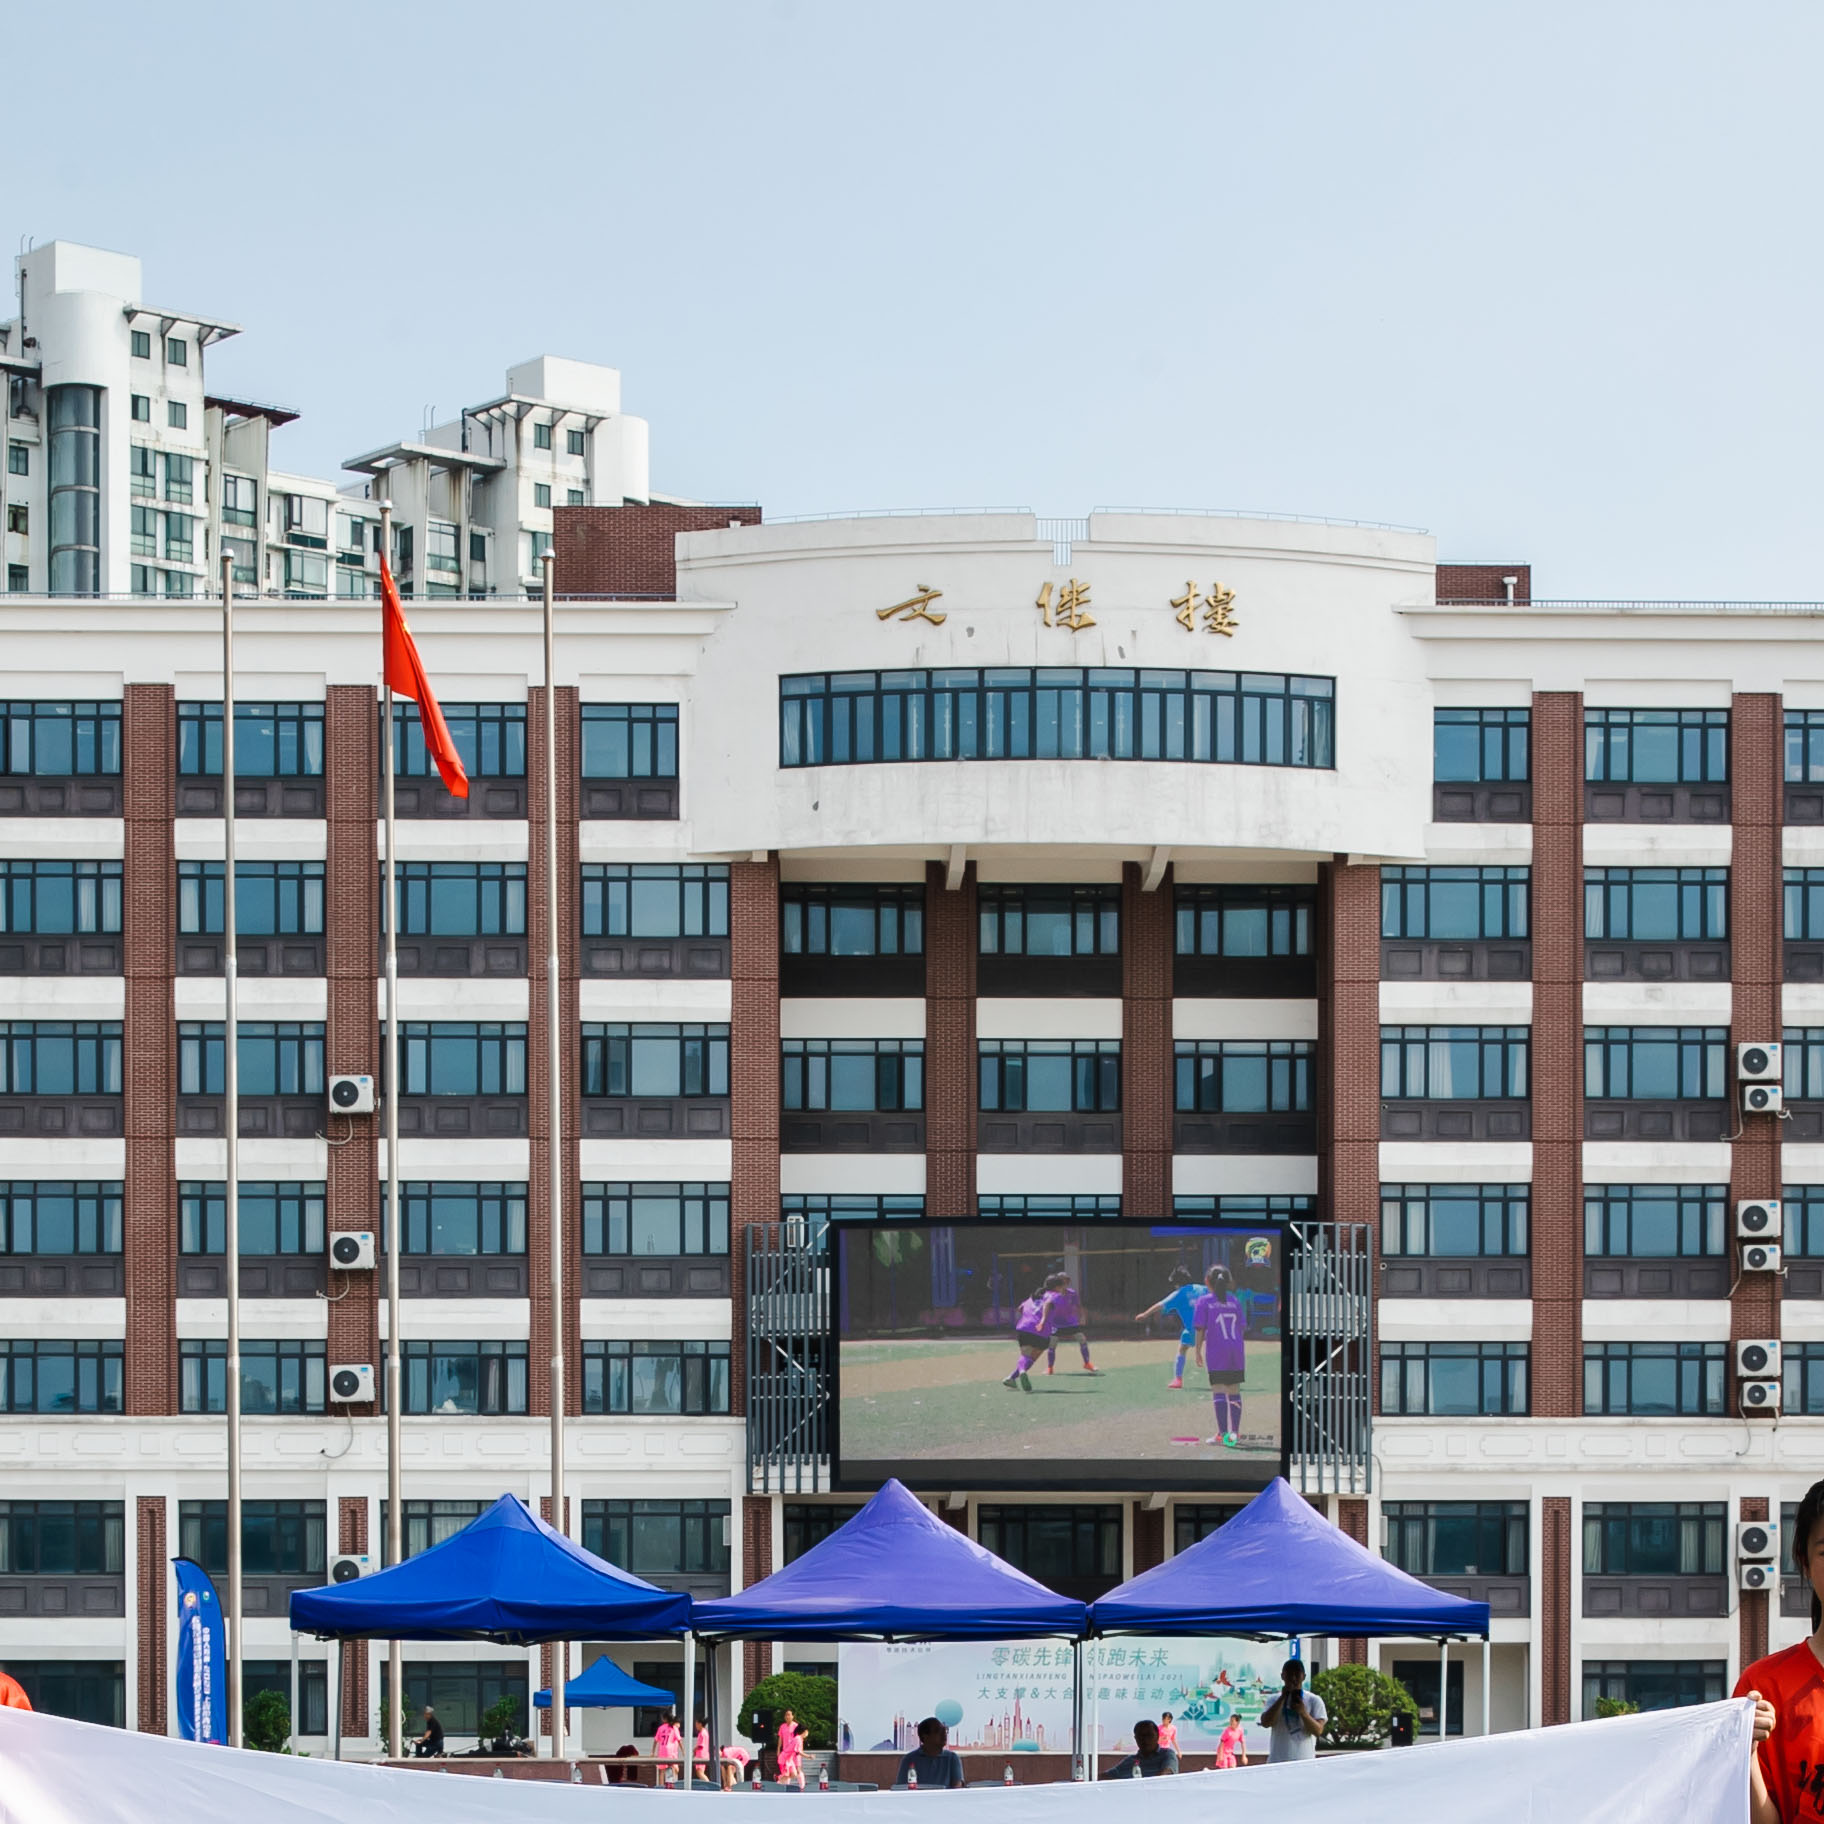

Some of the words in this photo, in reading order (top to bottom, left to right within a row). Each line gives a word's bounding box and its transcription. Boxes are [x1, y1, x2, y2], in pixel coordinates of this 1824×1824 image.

[1216, 1313, 1237, 1339] 17
[991, 1647, 1073, 1667] 零碳先锋
[1087, 1647, 1169, 1668] 领跑未来
